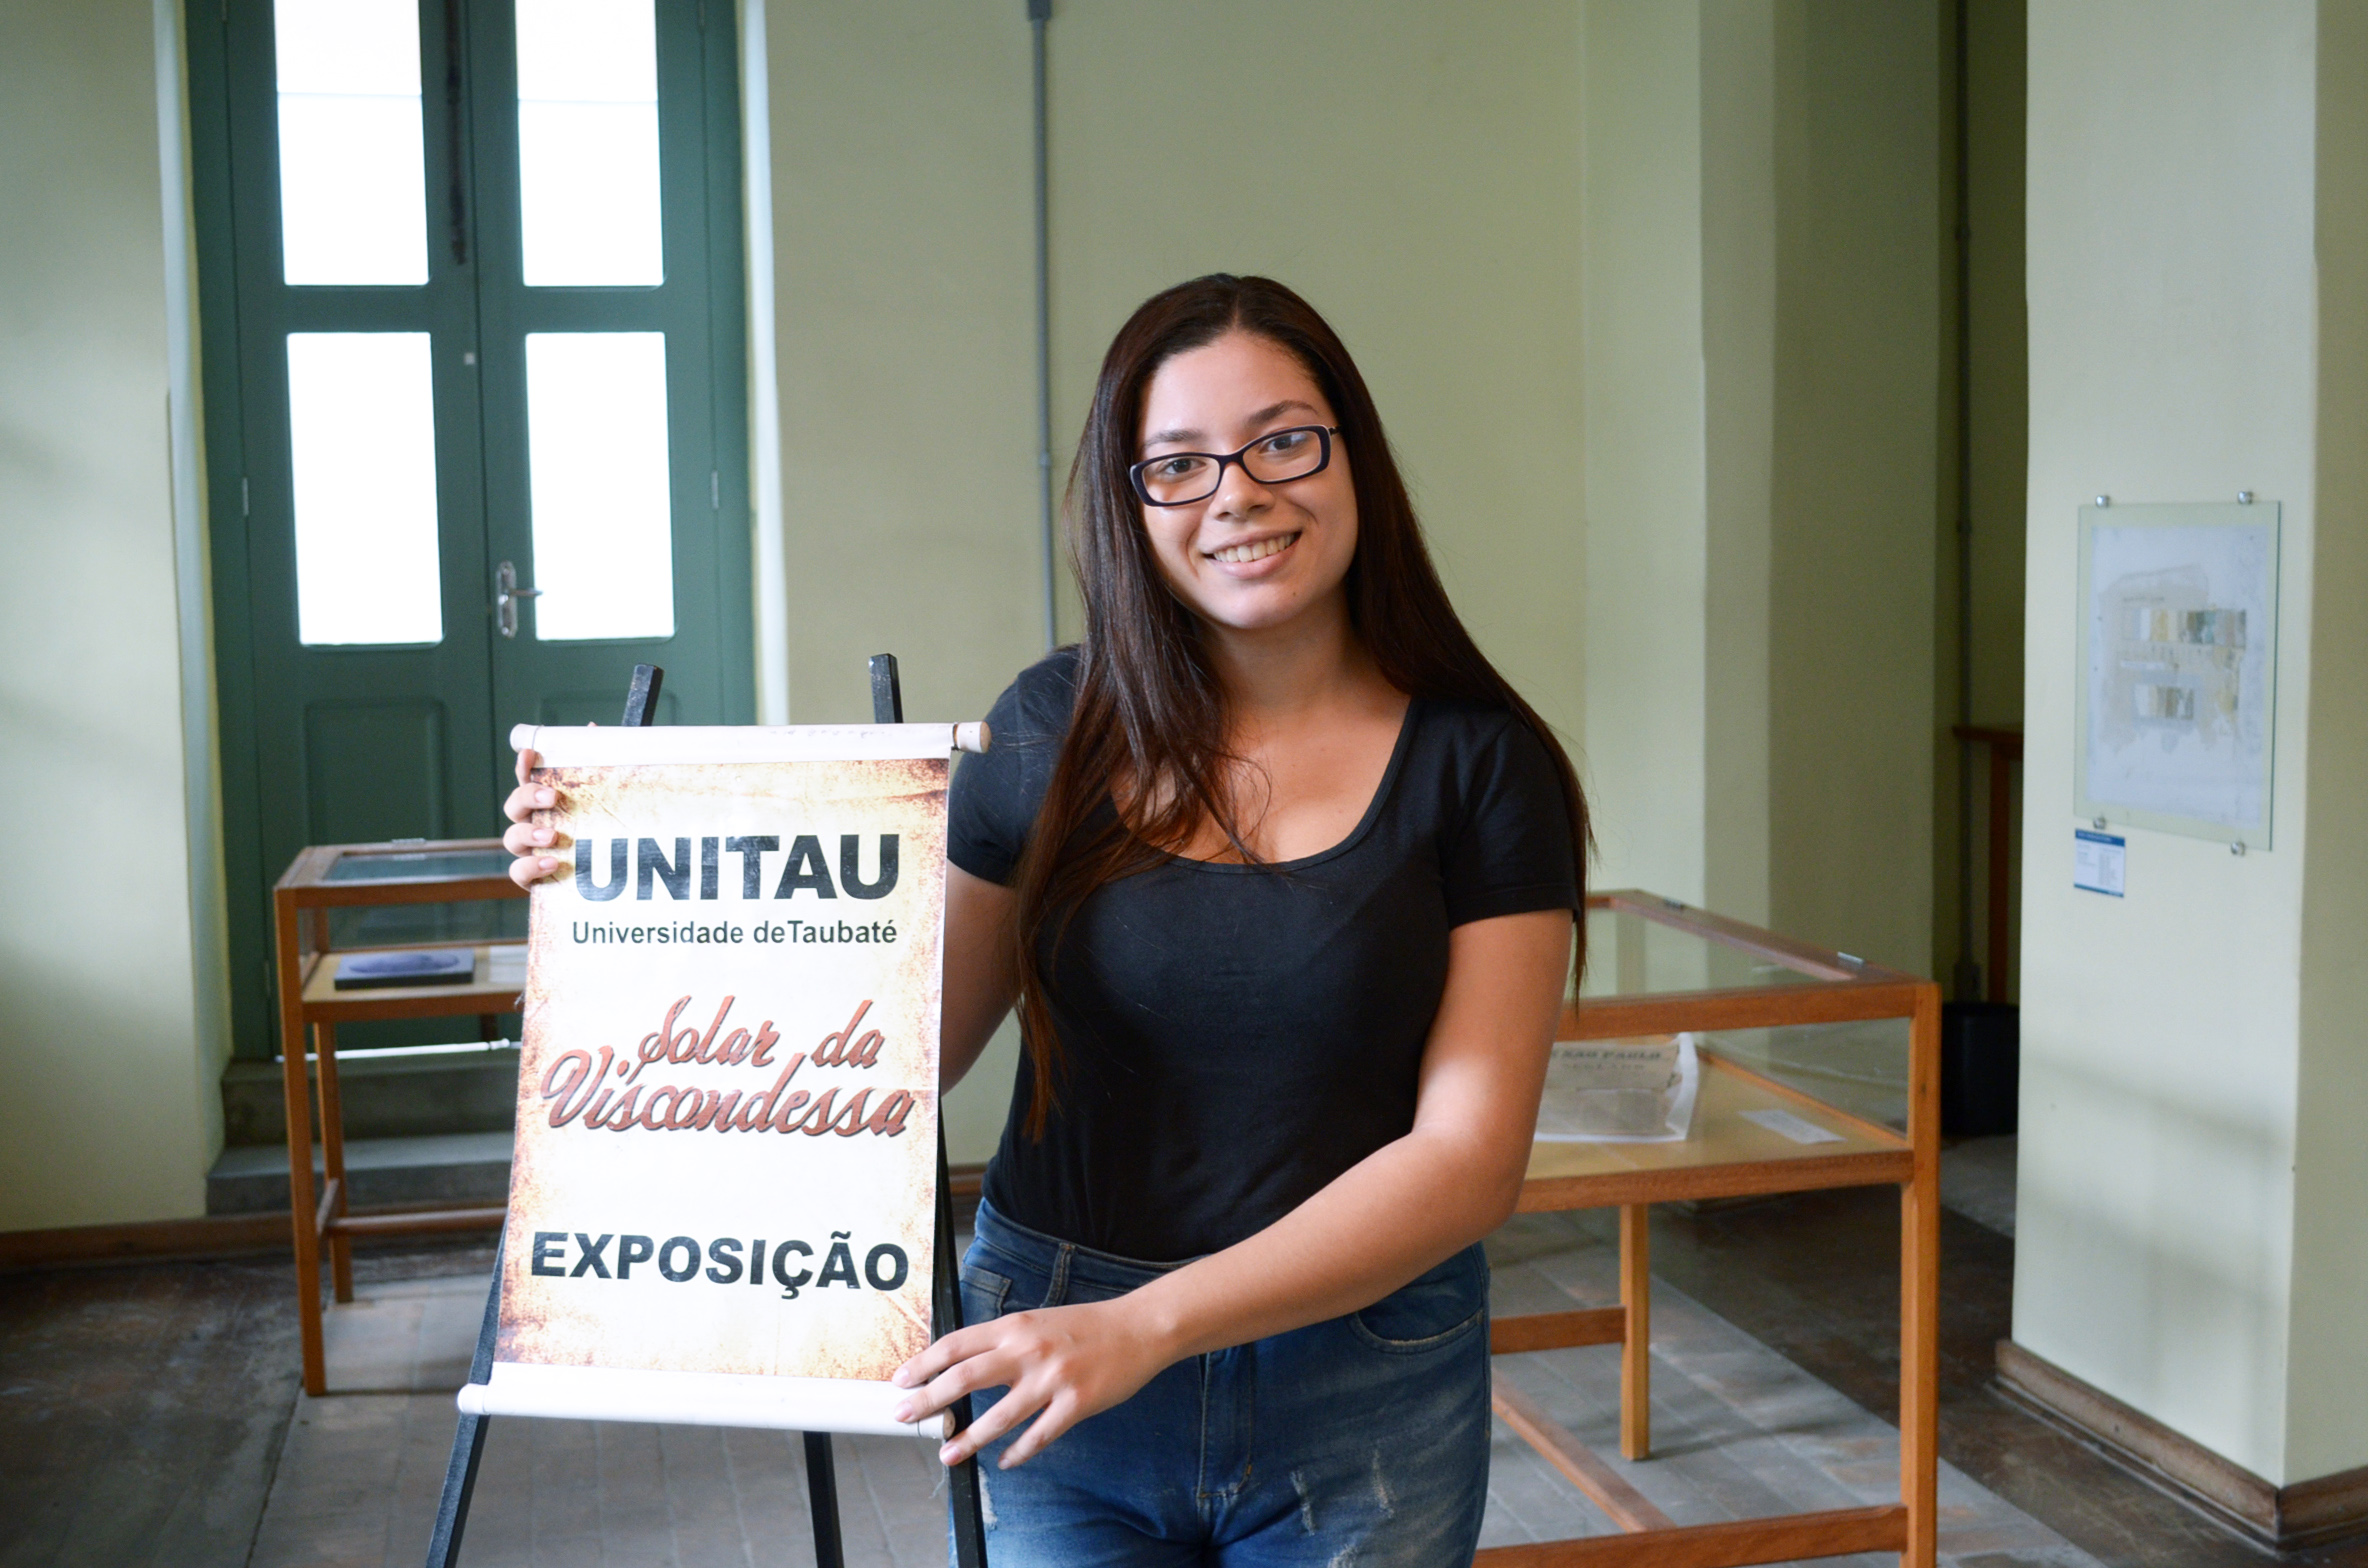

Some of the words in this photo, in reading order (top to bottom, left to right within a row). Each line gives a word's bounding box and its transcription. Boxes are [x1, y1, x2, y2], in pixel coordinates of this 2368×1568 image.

[575, 834, 900, 902] UNITAU
[572, 921, 744, 944] Universidade
[625, 995, 780, 1085] Solar
[811, 999, 886, 1069] da
[540, 1045, 916, 1137] Viscondessa
[531, 1231, 909, 1300] EXPOSIÇÃO
